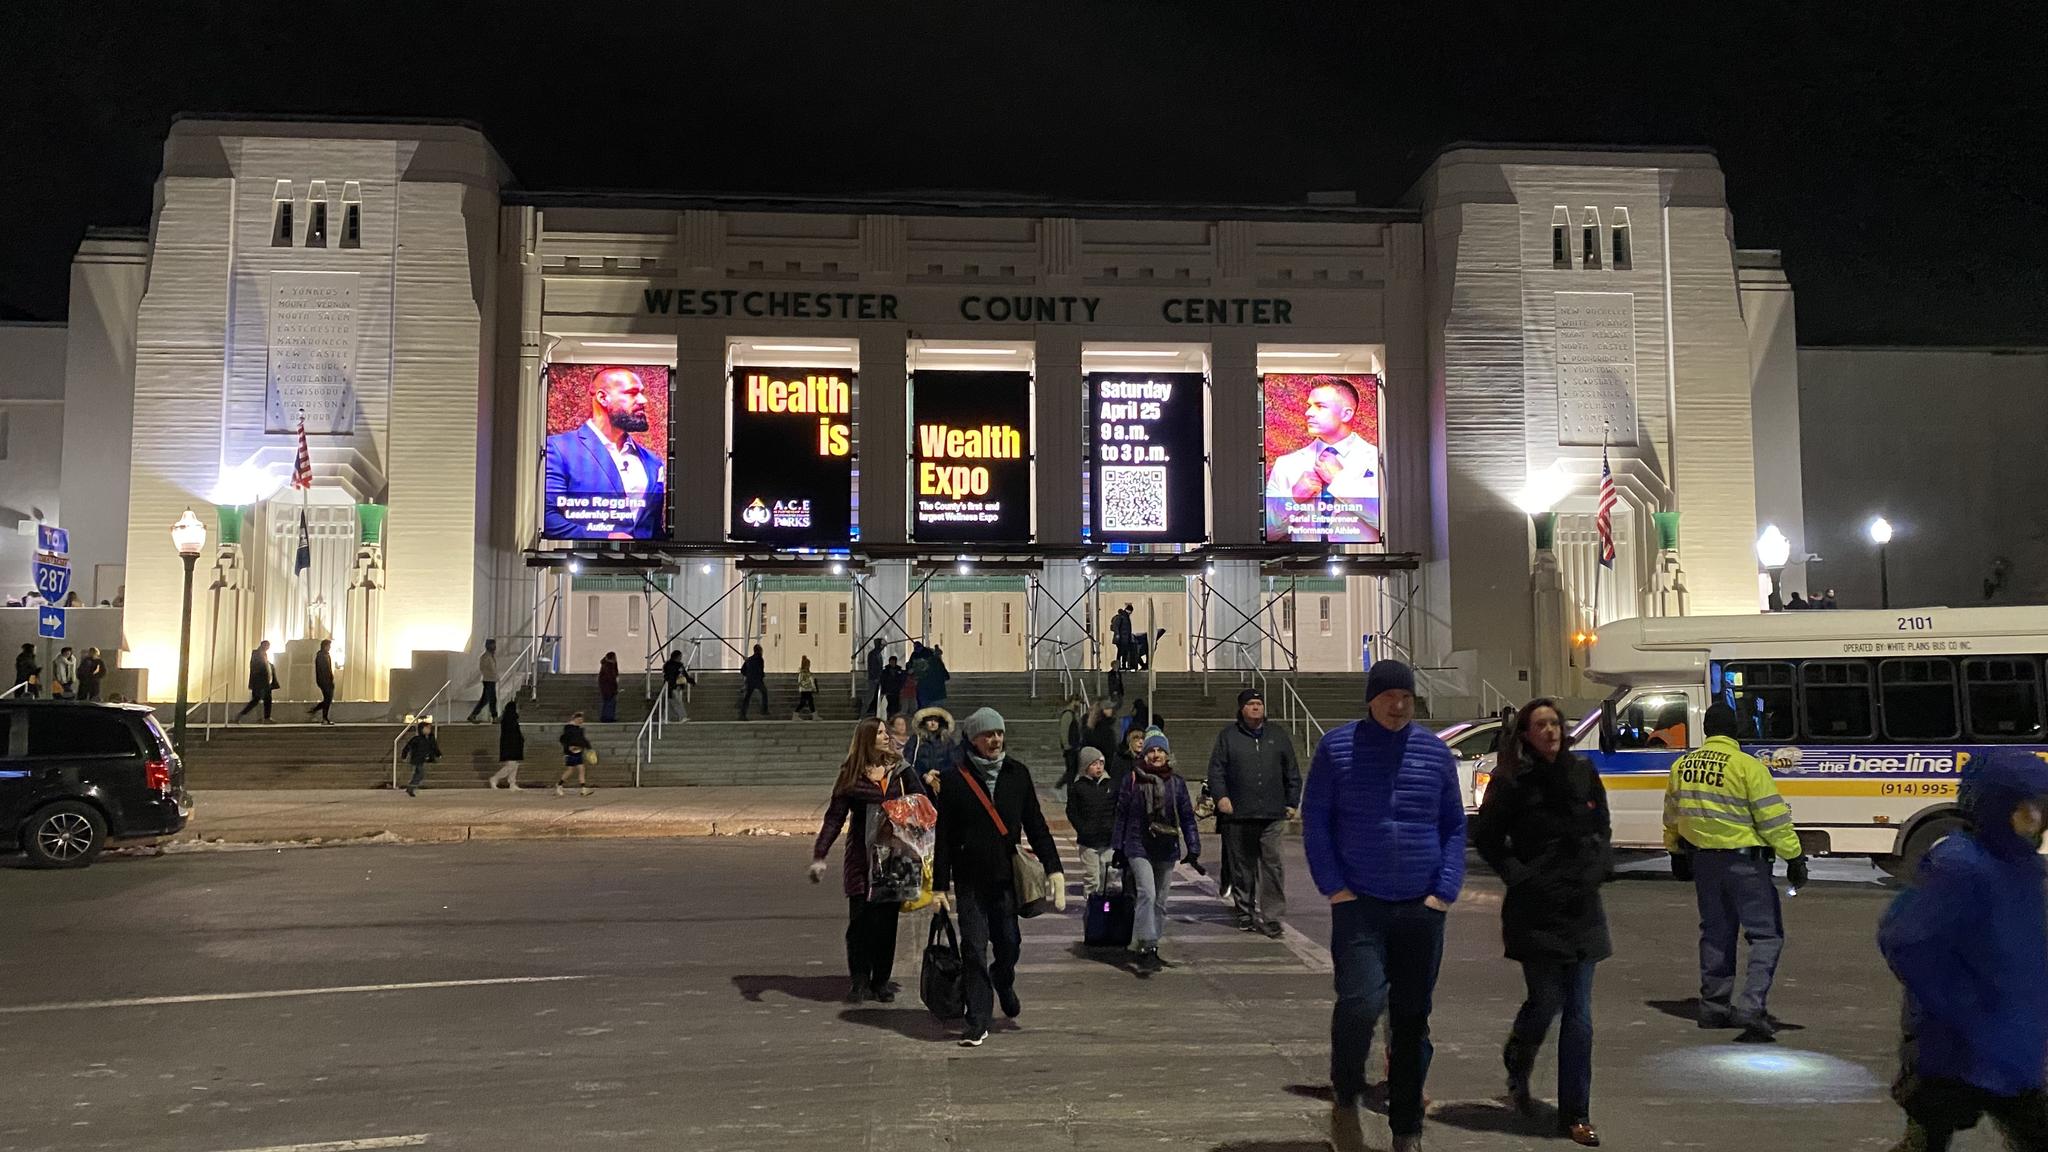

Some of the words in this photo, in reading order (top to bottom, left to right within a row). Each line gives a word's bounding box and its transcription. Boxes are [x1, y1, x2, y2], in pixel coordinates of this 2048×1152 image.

[643, 288, 898, 319] WESTCHESTER
[959, 295, 1100, 322] COUNTY
[1162, 298, 1292, 324] CENTER
[747, 375, 849, 414] Health
[1100, 380, 1172, 402] Saturday
[1100, 400, 1138, 422] April
[1140, 402, 1161, 420] 25
[819, 417, 849, 456] is
[1100, 422, 1112, 440] 9
[1114, 424, 1150, 440] a.m.
[920, 424, 1020, 458] Wealth
[1100, 444, 1119, 462] to
[1120, 444, 1132, 462] 3
[1134, 446, 1170, 464] p.m.
[920, 462, 989, 500] Expo
[556, 496, 589, 508] Dave
[592, 496, 646, 509] Reggina
[774, 500, 810, 510] A.C.E
[919, 502, 934, 510] The
[934, 502, 966, 512] County's
[968, 502, 983, 510] first
[984, 502, 1000, 510] and
[1284, 502, 1315, 512] Sean
[1318, 502, 1363, 513] Degnan
[565, 510, 610, 521] Leadership
[919, 512, 944, 523] largest
[944, 512, 978, 522] Wellness
[978, 512, 998, 524] Expo
[1289, 514, 1310, 523] Serial
[1312, 515, 1359, 524] Entrepreneur
[586, 522, 615, 532] Author
[1288, 526, 1334, 534] Performance
[44, 530, 60, 547] TO
[40, 568, 66, 593] 287
[1897, 616, 1933, 630] 2101
[1843, 644, 1874, 653] OPERATED
[1887, 642, 1904, 652] WHITE
[1908, 642, 1930, 652] PLAINS
[1932, 642, 1946, 650] BUS
[1678, 760, 1727, 772] COUNTY
[1818, 762, 1845, 773] the
[1848, 752, 1953, 773] bee-line
[1678, 770, 1724, 788] POLICE
[1881, 783, 1918, 796] (914)
